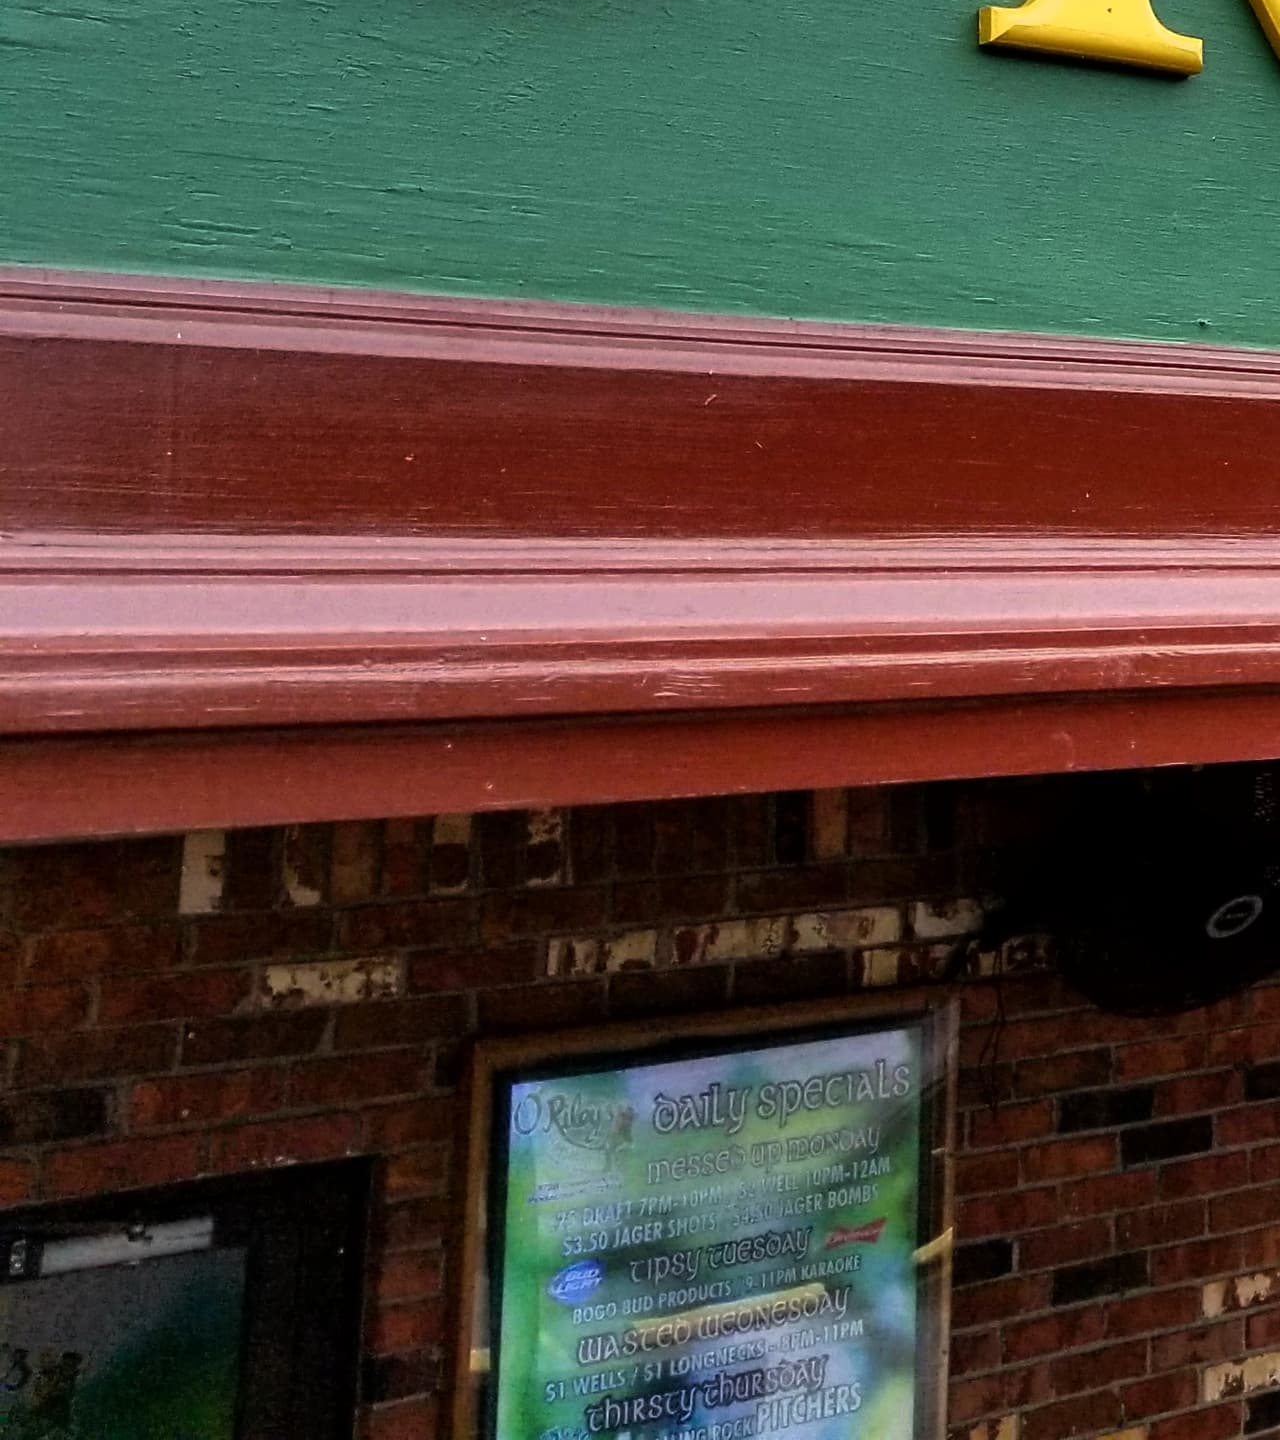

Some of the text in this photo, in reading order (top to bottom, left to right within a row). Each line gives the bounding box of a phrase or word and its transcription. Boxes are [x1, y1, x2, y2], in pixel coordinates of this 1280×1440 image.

[762, 1175, 799, 1194] WELL
[806, 1157, 890, 1186] 10PM-12AM
[563, 1232, 608, 1256] $3.50
[613, 1222, 661, 1248] JAGER
[668, 1213, 718, 1238] SHOTS
[779, 1194, 822, 1218] JAGER
[828, 1184, 878, 1209] BOMBS
[572, 1302, 617, 1325] BOGO
[622, 1295, 654, 1315] BUD
[658, 1280, 731, 1308] PRODUCTS
[801, 1255, 861, 1281] KARAOKE
[545, 1381, 566, 1403] $1
[573, 1370, 625, 1395] WELLS
[644, 1362, 662, 1382] $1
[670, 1339, 765, 1376] LONGNECKS
[713, 1417, 752, 1440] ROCK
[756, 1382, 863, 1434] PITCHERS
